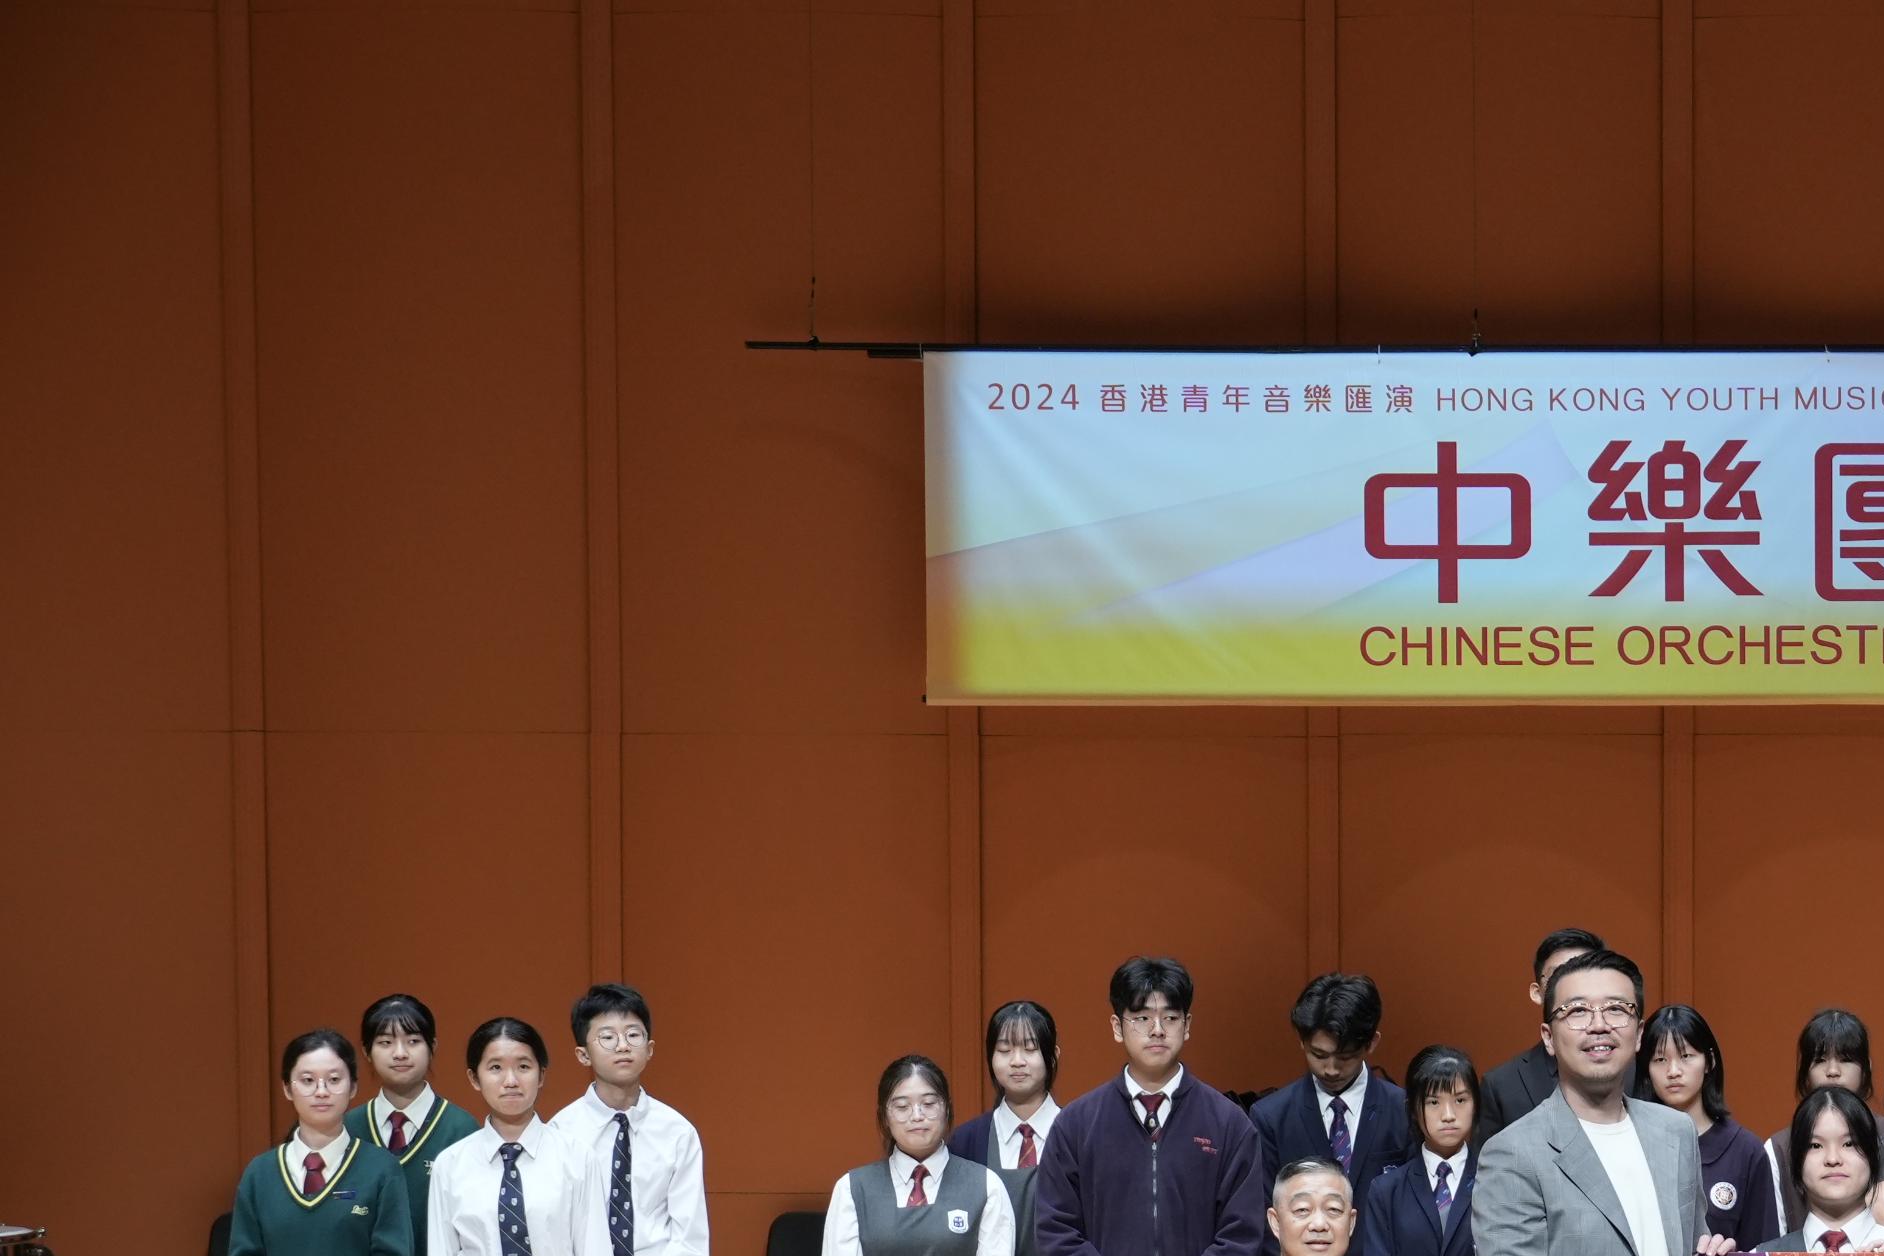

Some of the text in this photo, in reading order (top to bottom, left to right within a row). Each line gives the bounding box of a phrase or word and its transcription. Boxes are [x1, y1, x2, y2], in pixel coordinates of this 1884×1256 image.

[988, 382, 1414, 413] 2024 香港青年音樂匯演
[1437, 387, 1533, 412] HONG
[1549, 387, 1645, 412] KONG
[1661, 387, 1779, 411] YOUTH
[1360, 626, 1593, 667] CHINESE
